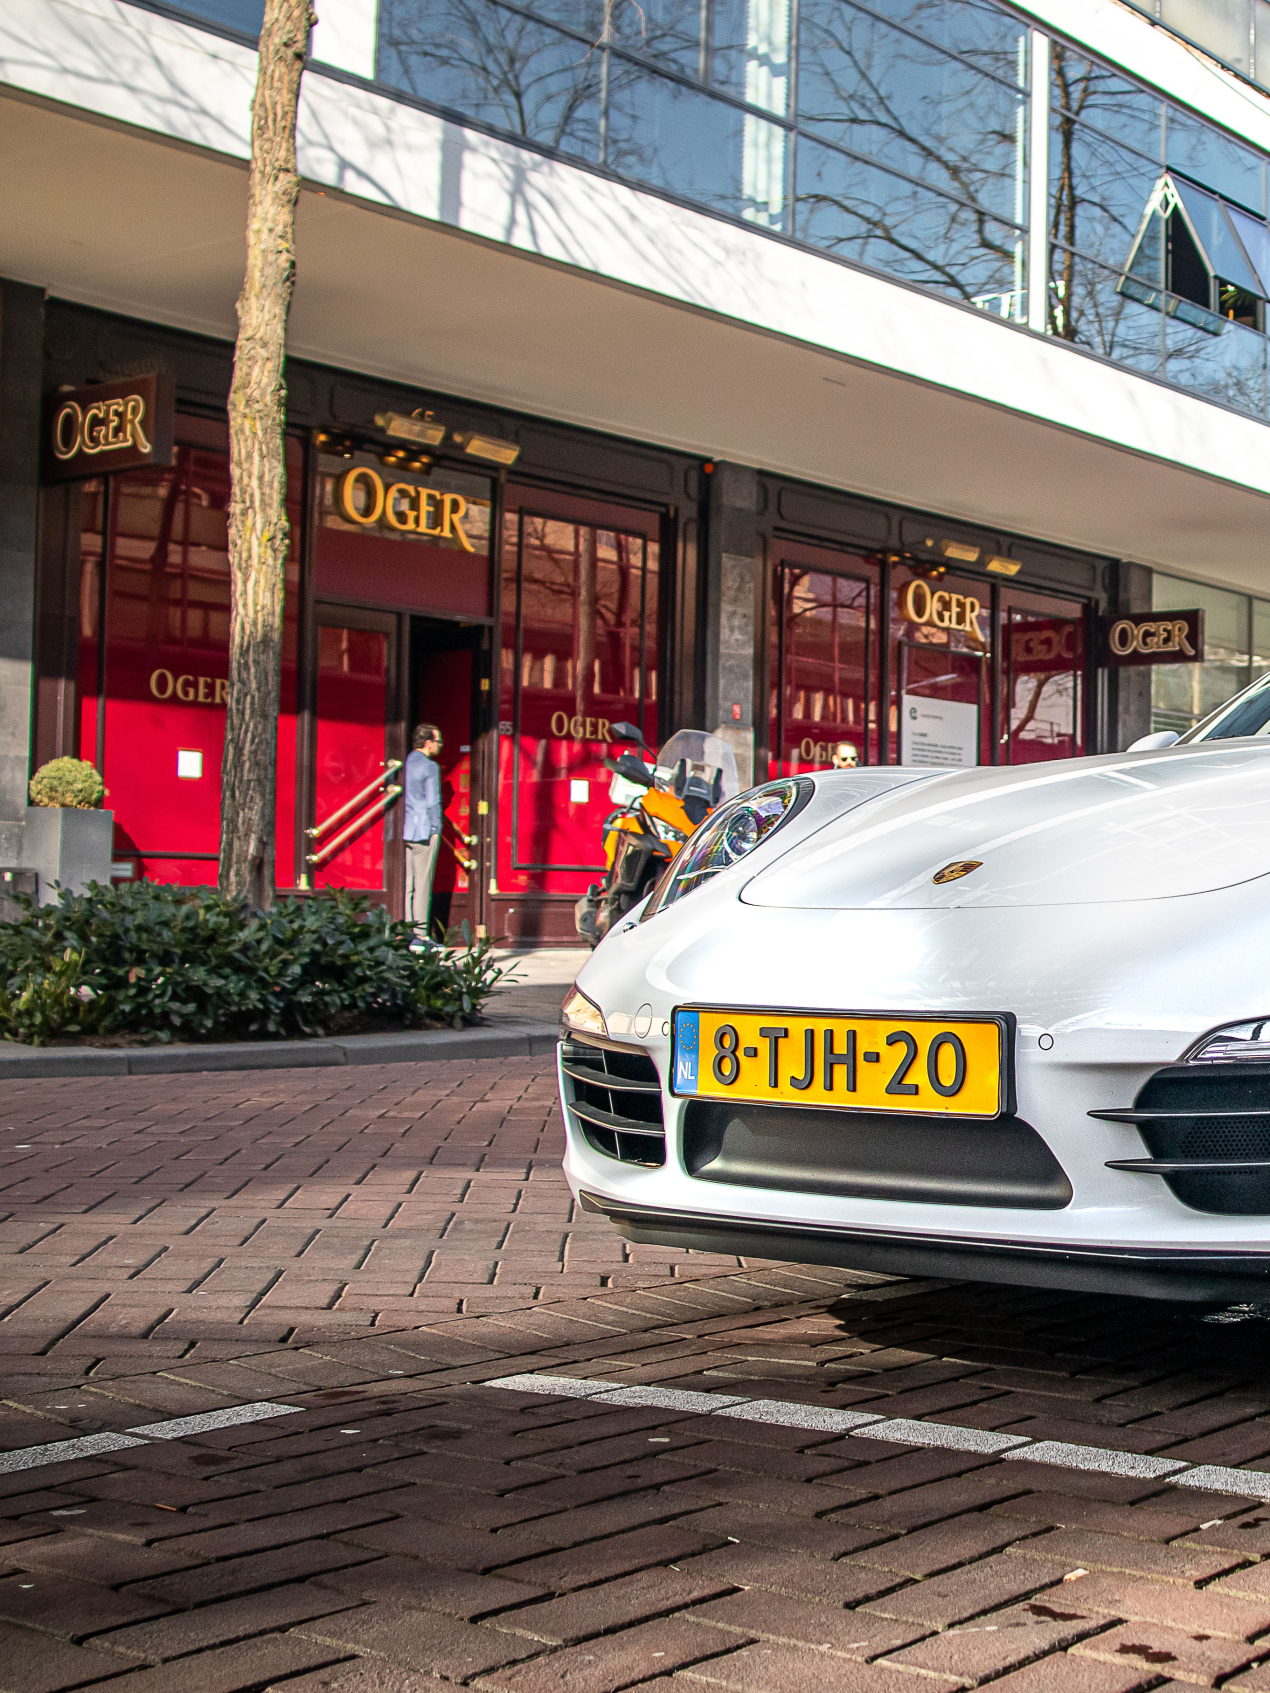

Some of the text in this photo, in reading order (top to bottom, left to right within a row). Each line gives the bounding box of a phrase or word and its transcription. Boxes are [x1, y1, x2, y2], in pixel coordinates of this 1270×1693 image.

[54, 394, 152, 460] OGER
[343, 467, 475, 553] OGER
[907, 579, 985, 642] OGER
[1109, 620, 1196, 656] OGER
[150, 669, 229, 705] OGER
[551, 711, 613, 743] OGER
[677, 1060, 696, 1081] NL
[712, 1023, 968, 1098] 8-TJH-20
